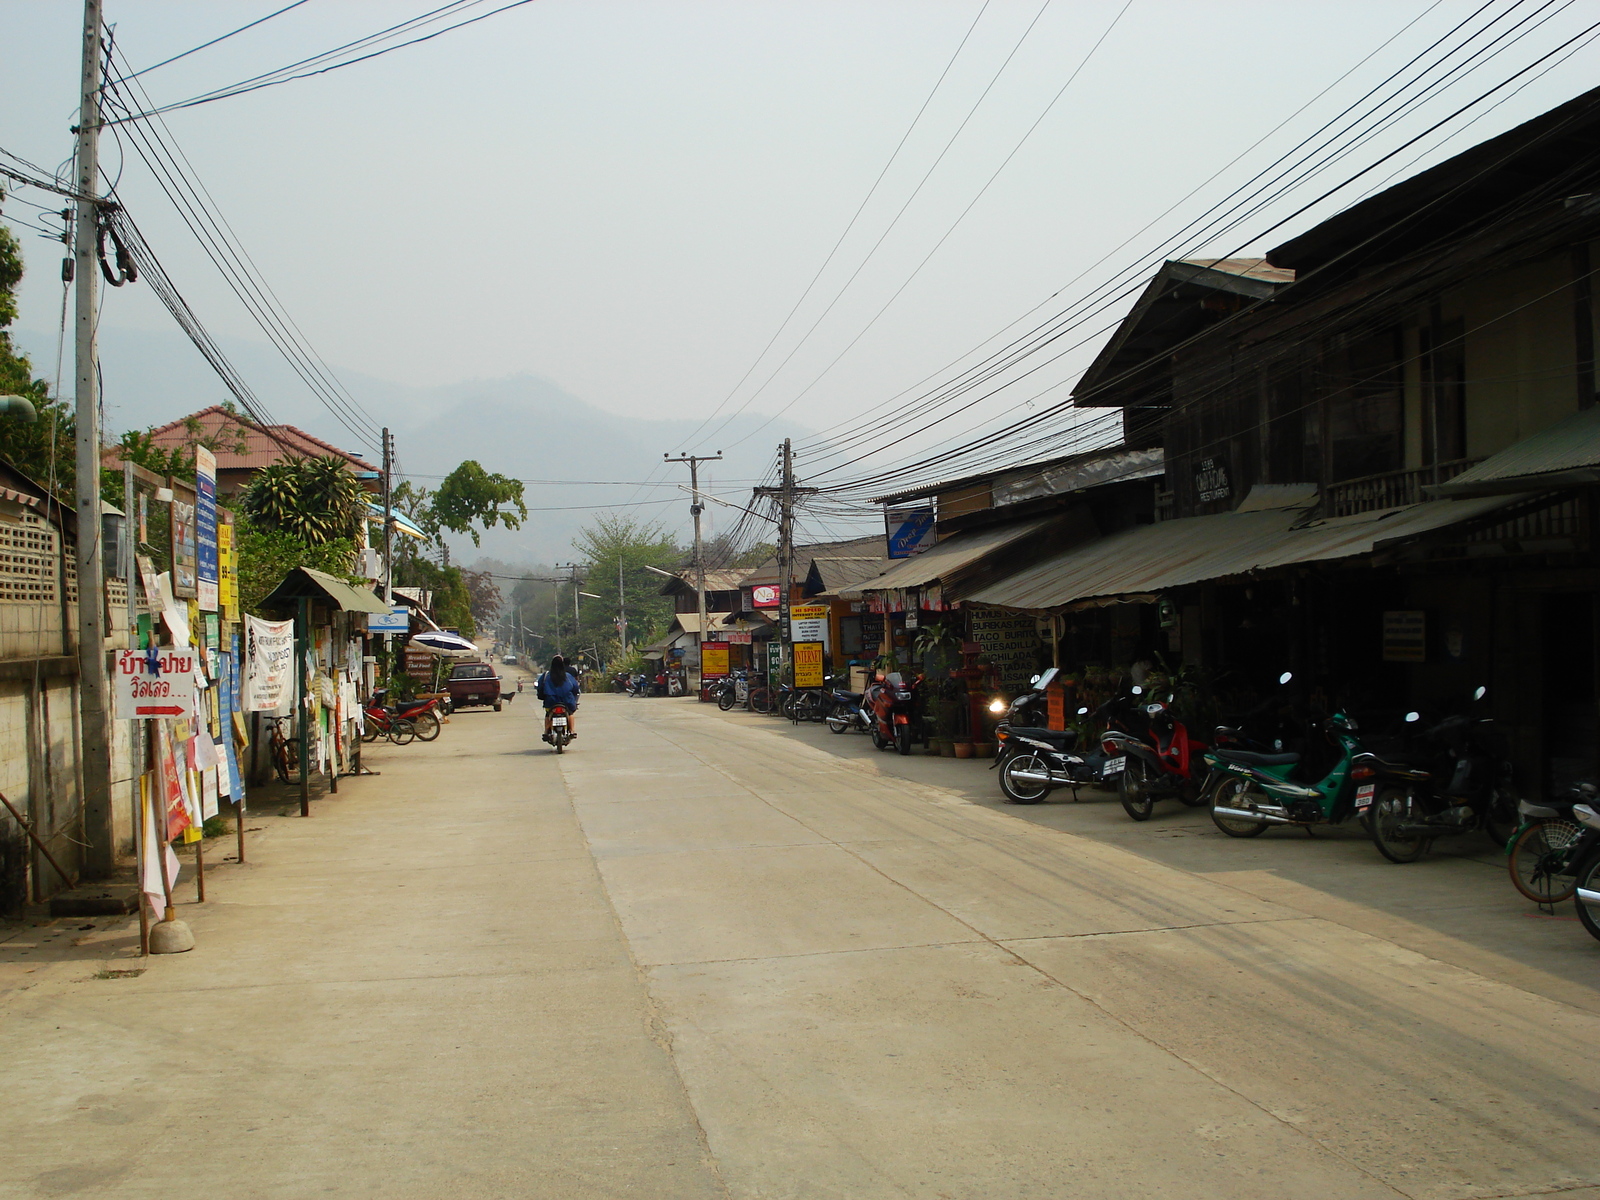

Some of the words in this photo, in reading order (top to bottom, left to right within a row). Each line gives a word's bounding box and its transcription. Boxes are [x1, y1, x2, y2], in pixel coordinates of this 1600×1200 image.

[974, 633, 1000, 641] TACO
[795, 650, 821, 663] INTERNET
[988, 652, 1037, 662] CHILADAS
[119, 650, 192, 675] บ้าปาย
[997, 663, 1033, 671] STADAS
